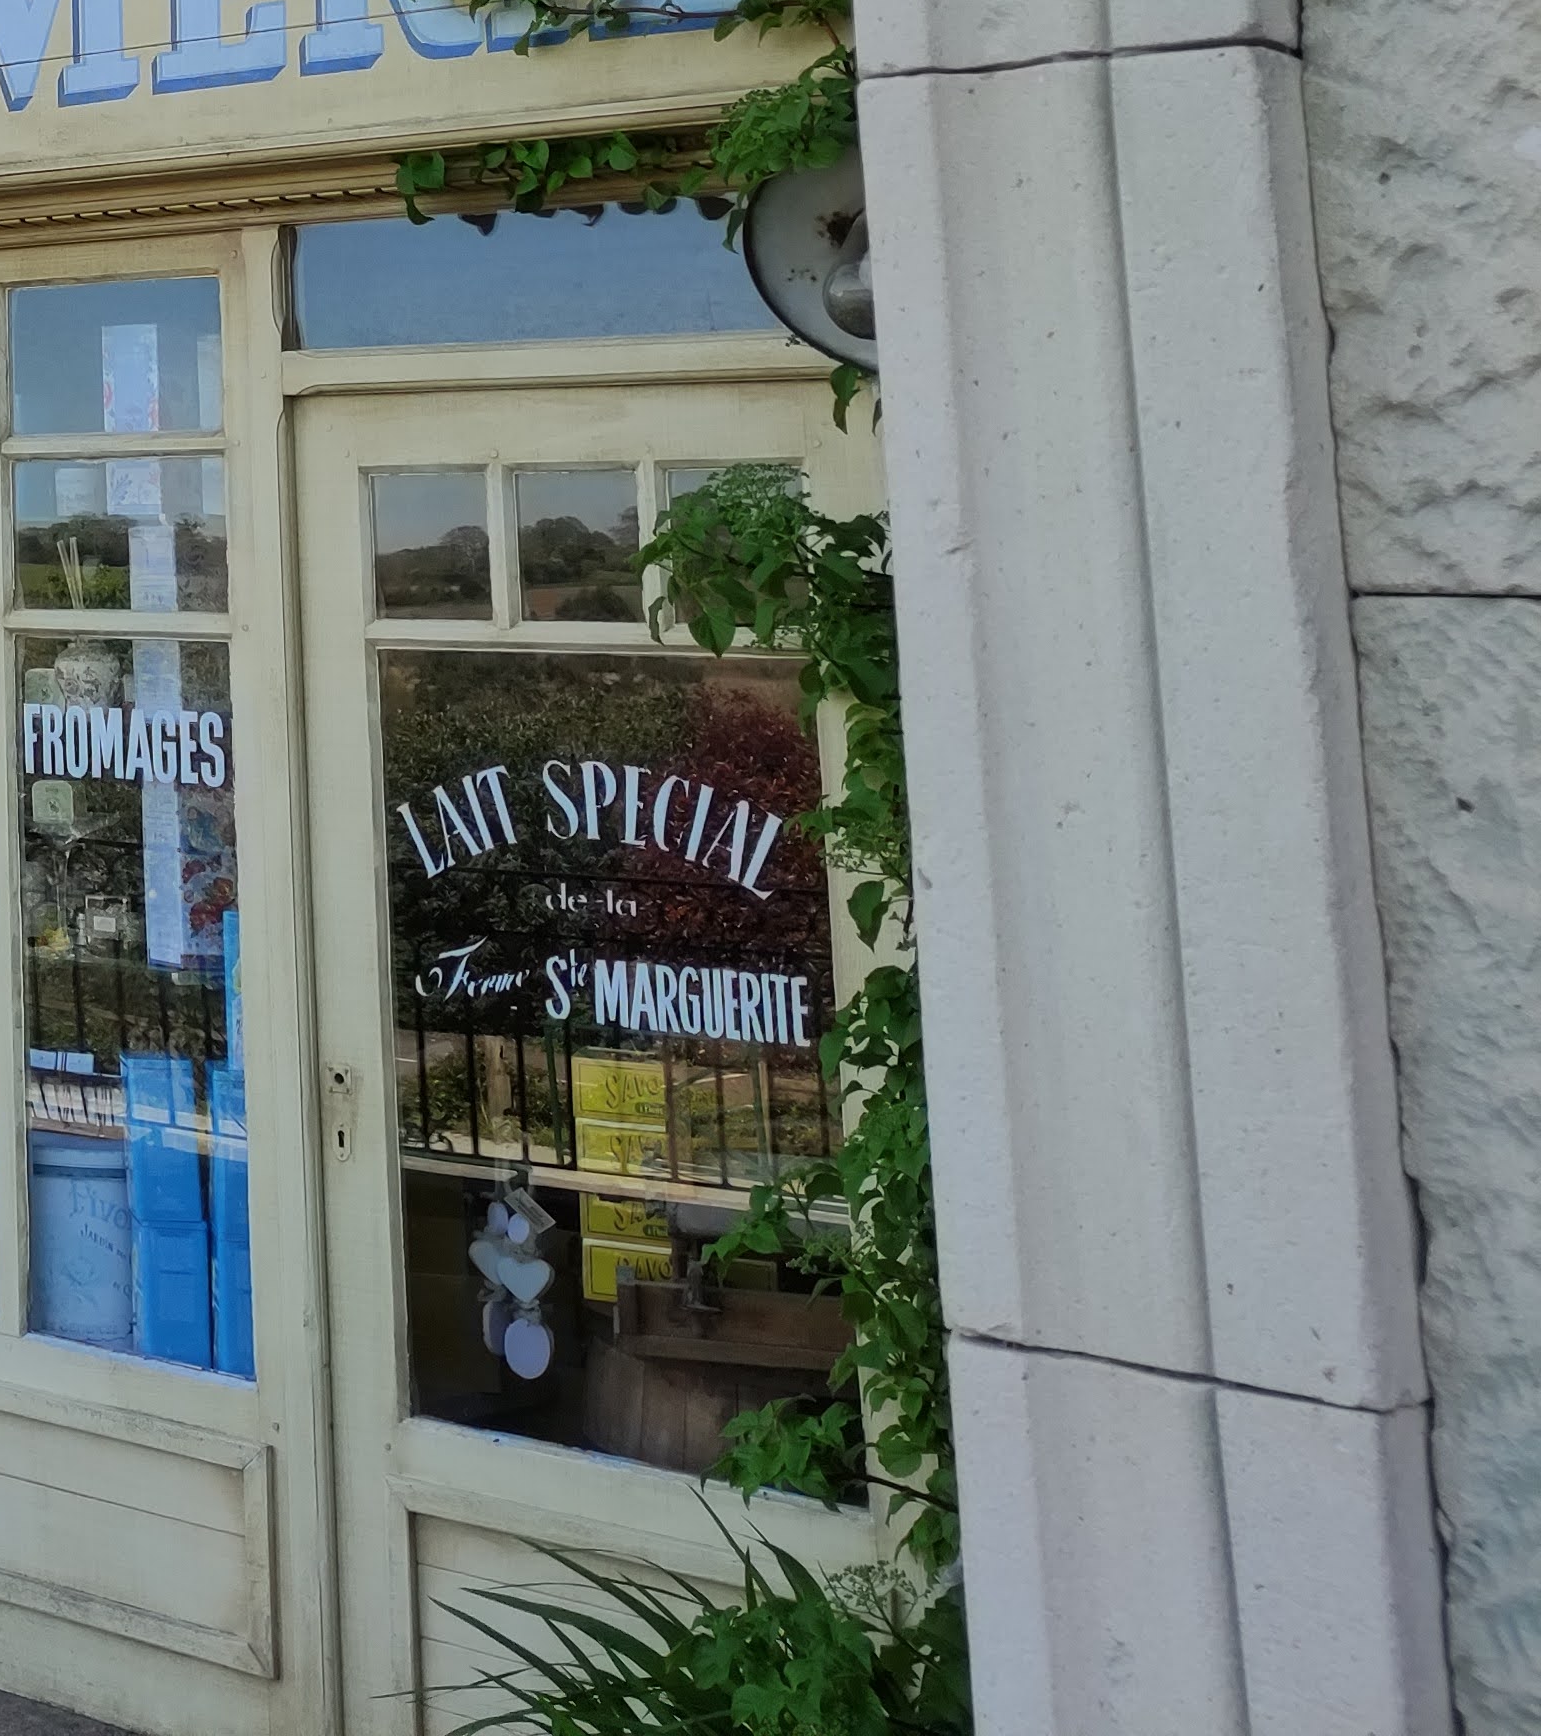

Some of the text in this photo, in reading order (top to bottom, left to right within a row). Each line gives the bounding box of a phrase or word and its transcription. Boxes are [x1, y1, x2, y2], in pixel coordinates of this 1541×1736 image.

[23, 703, 225, 789] FROMAGES
[397, 765, 517, 880] LAIT
[545, 882, 587, 912] de
[594, 958, 810, 1047] MARGUERITE
